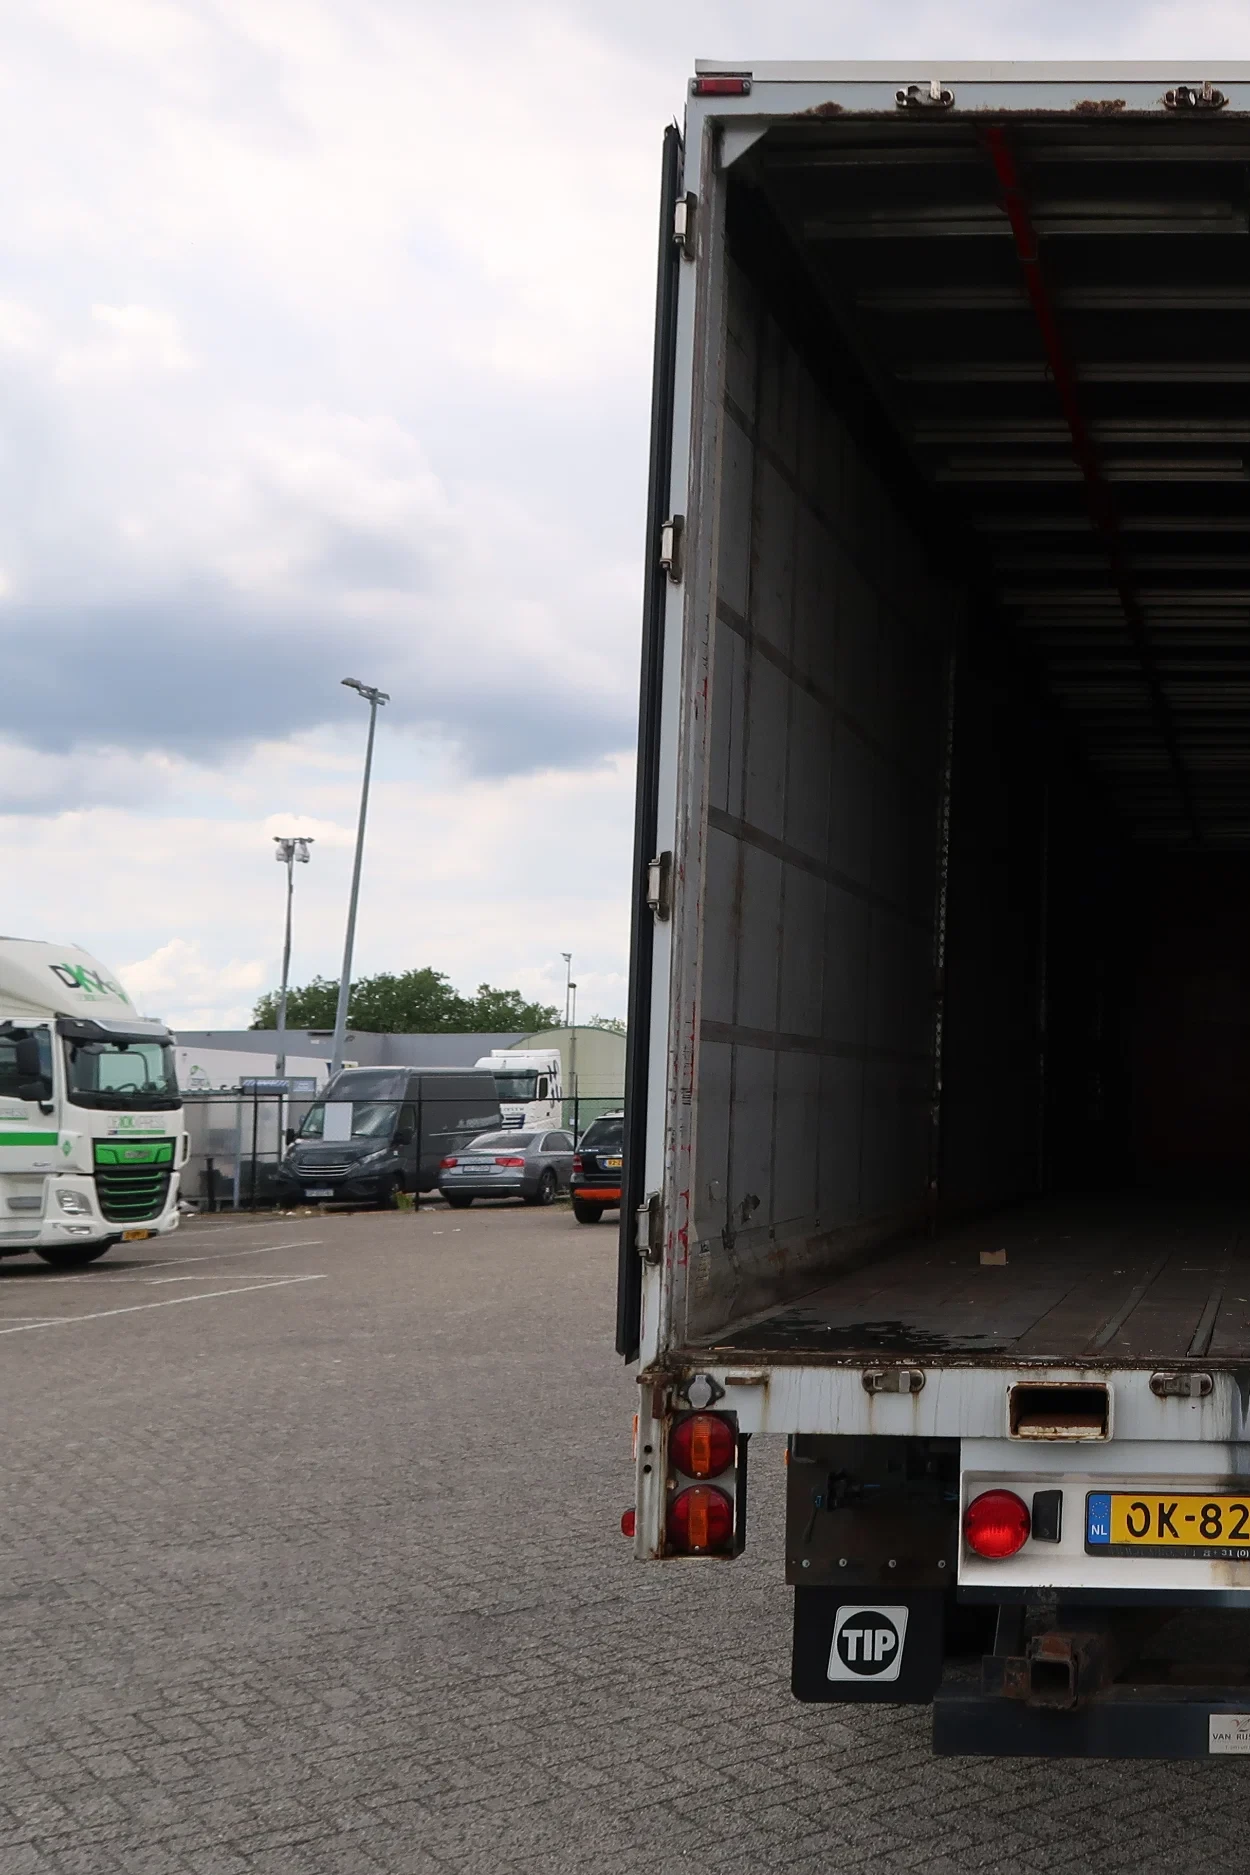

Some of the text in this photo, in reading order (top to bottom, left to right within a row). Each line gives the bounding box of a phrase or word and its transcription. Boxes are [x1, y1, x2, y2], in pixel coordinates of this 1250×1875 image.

[1091, 1525, 1107, 1536] NL
[1236, 1549, 1250, 1558] (0)
[842, 1629, 896, 1661] TIP
